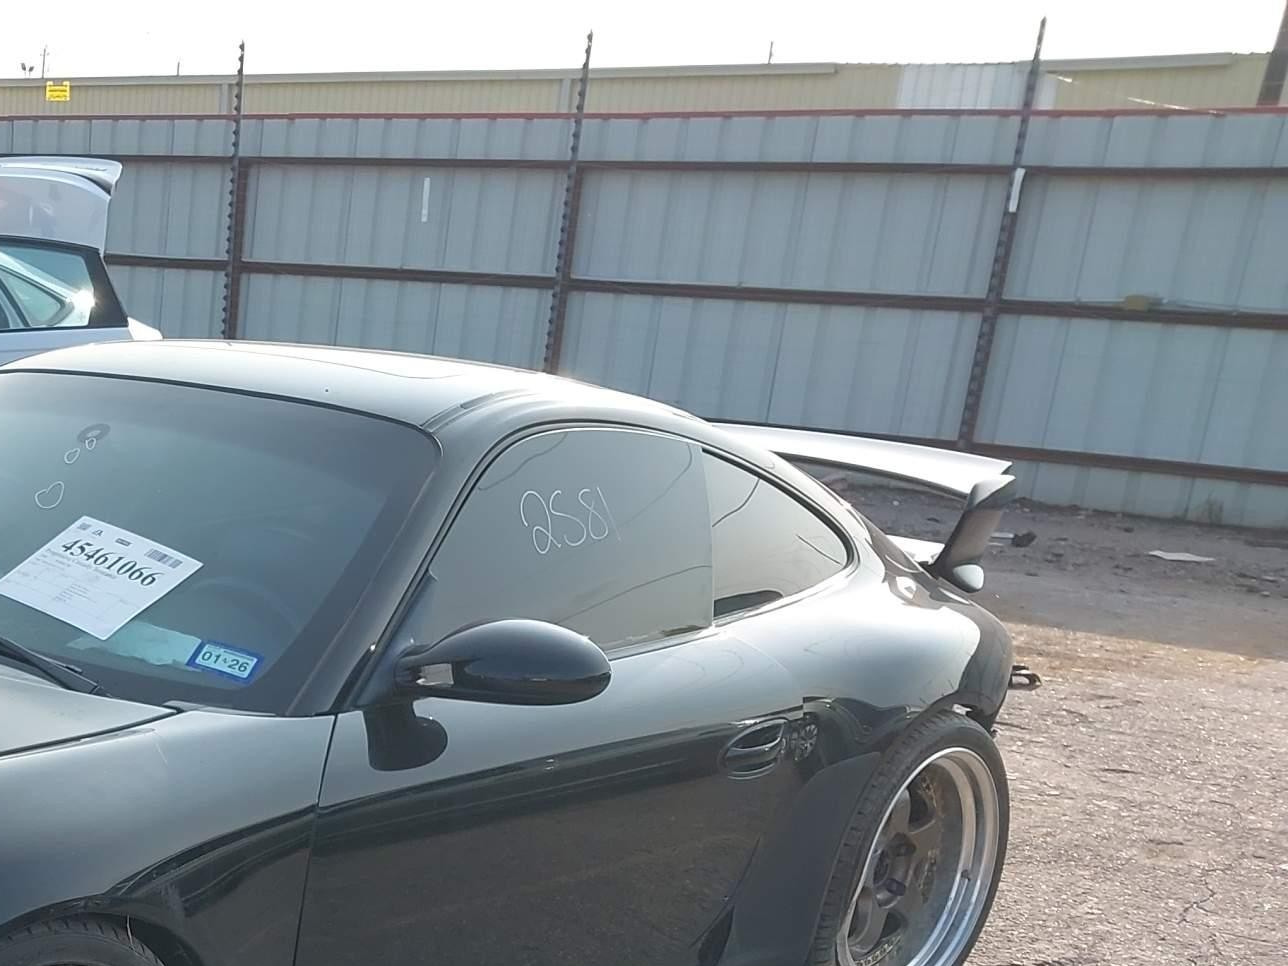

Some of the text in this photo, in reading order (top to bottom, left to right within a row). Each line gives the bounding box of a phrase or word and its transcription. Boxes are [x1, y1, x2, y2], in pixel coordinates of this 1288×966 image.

[520, 486, 621, 554] 2581
[62, 539, 165, 587] 45461066
[202, 651, 249, 672] 01 26
